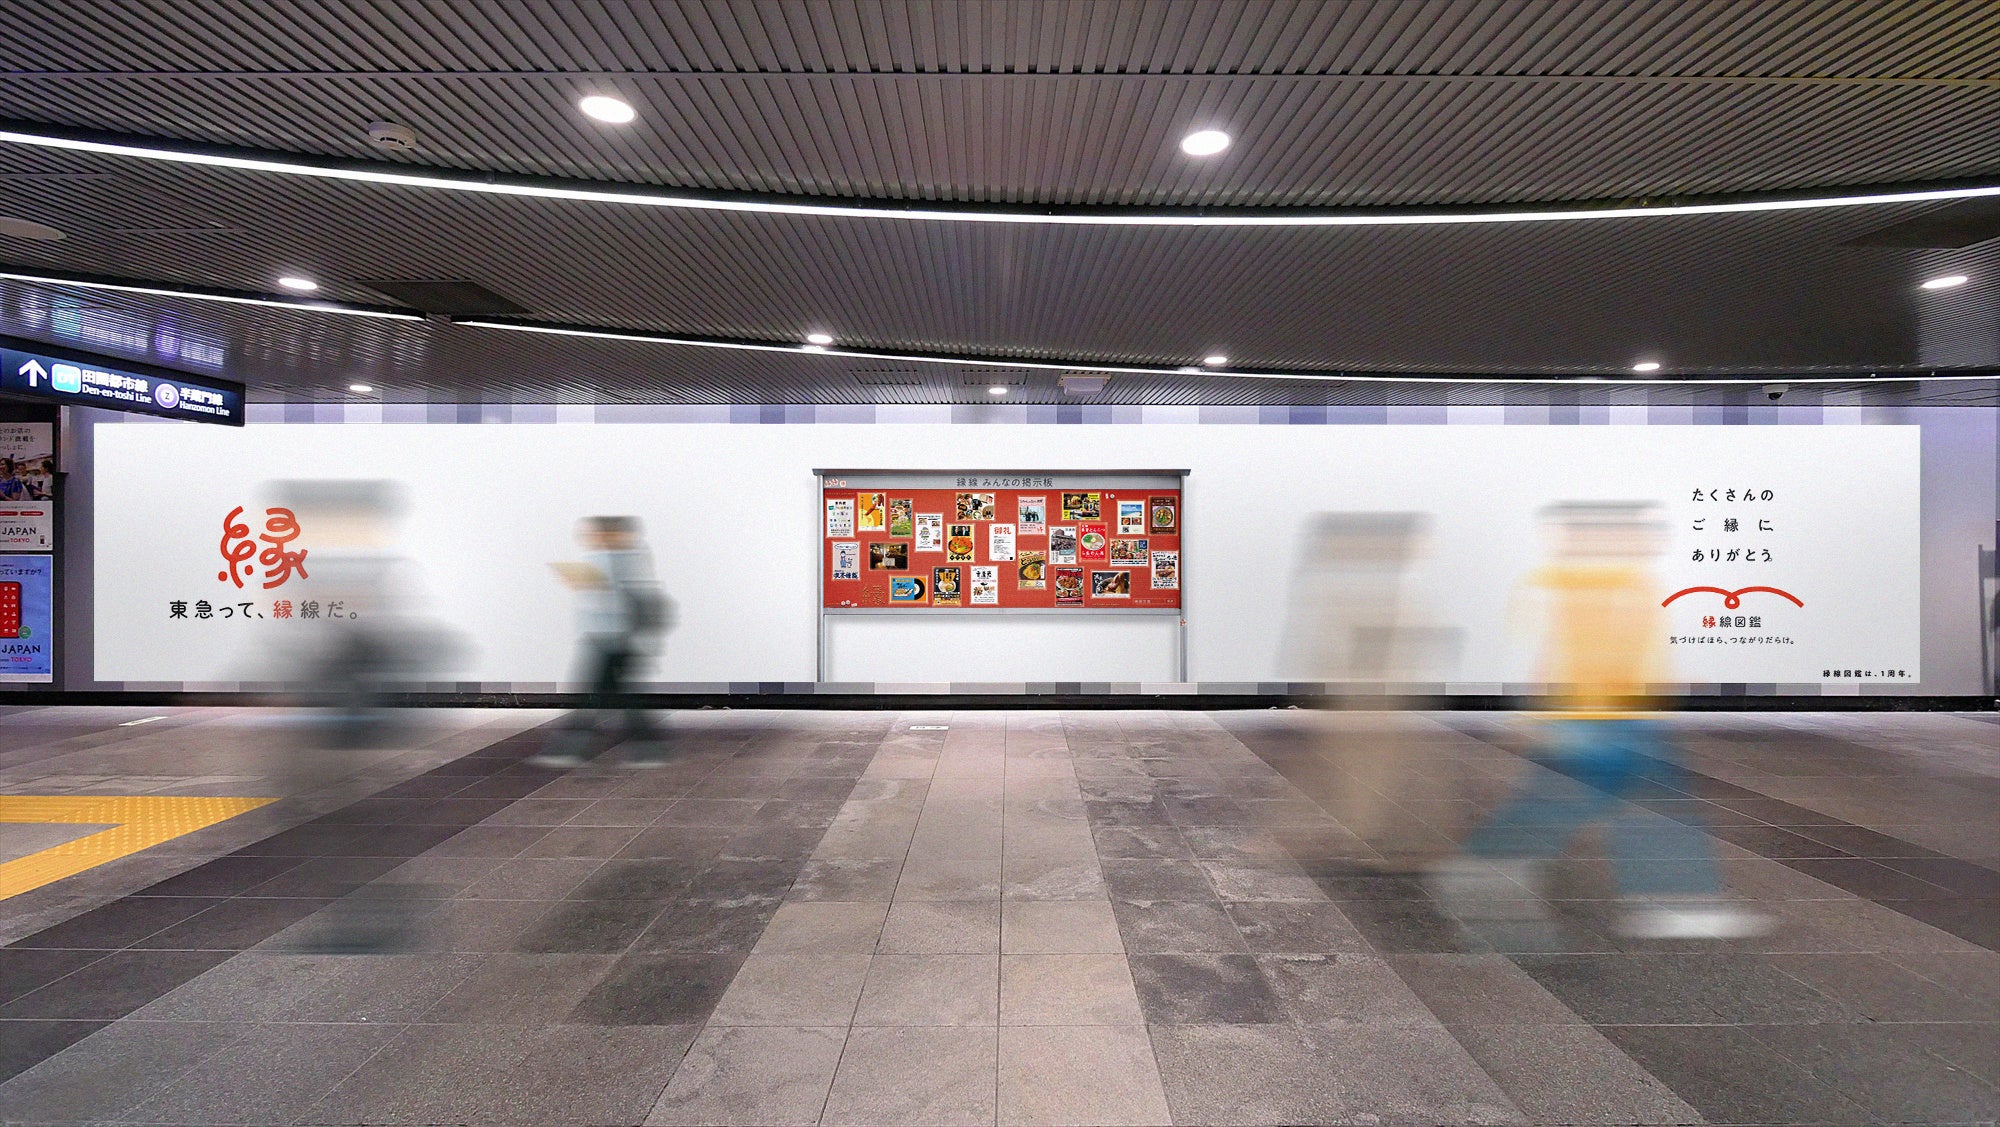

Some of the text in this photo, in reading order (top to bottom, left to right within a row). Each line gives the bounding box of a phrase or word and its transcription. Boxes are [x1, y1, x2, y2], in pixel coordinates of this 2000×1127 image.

[82, 384, 152, 404] Den-en-toshi Line
[180, 401, 230, 417] Hanzomon Line
[1692, 488, 1774, 502] たくさんの
[2, 527, 37, 536] JAPAN
[1692, 548, 1773, 562] ありがとう。
[1702, 615, 1761, 629] 縁線図鑑
[2, 645, 41, 654] JAPAN
